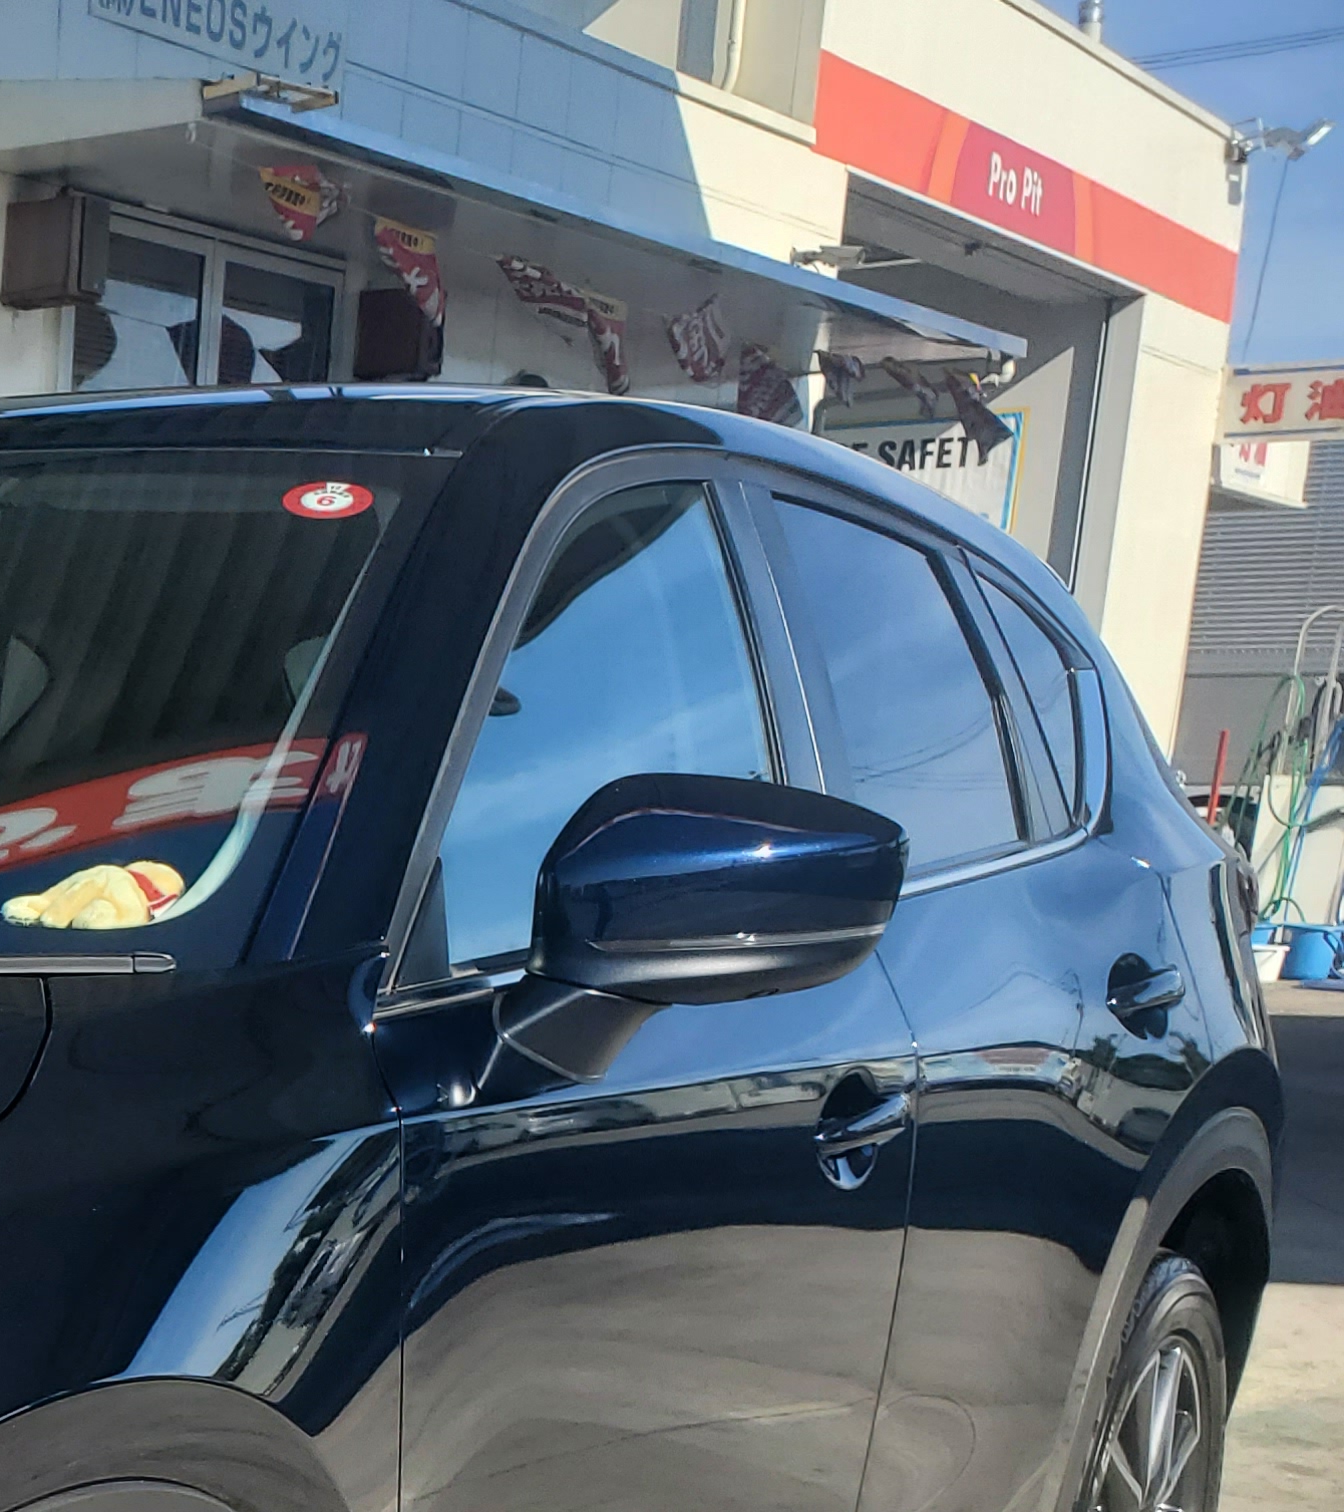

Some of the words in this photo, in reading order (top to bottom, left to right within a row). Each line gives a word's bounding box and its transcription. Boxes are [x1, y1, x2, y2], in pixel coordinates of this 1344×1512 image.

[988, 151, 1017, 206] Pro
[1021, 166, 1043, 216] Pit
[878, 436, 988, 472] SAFET
